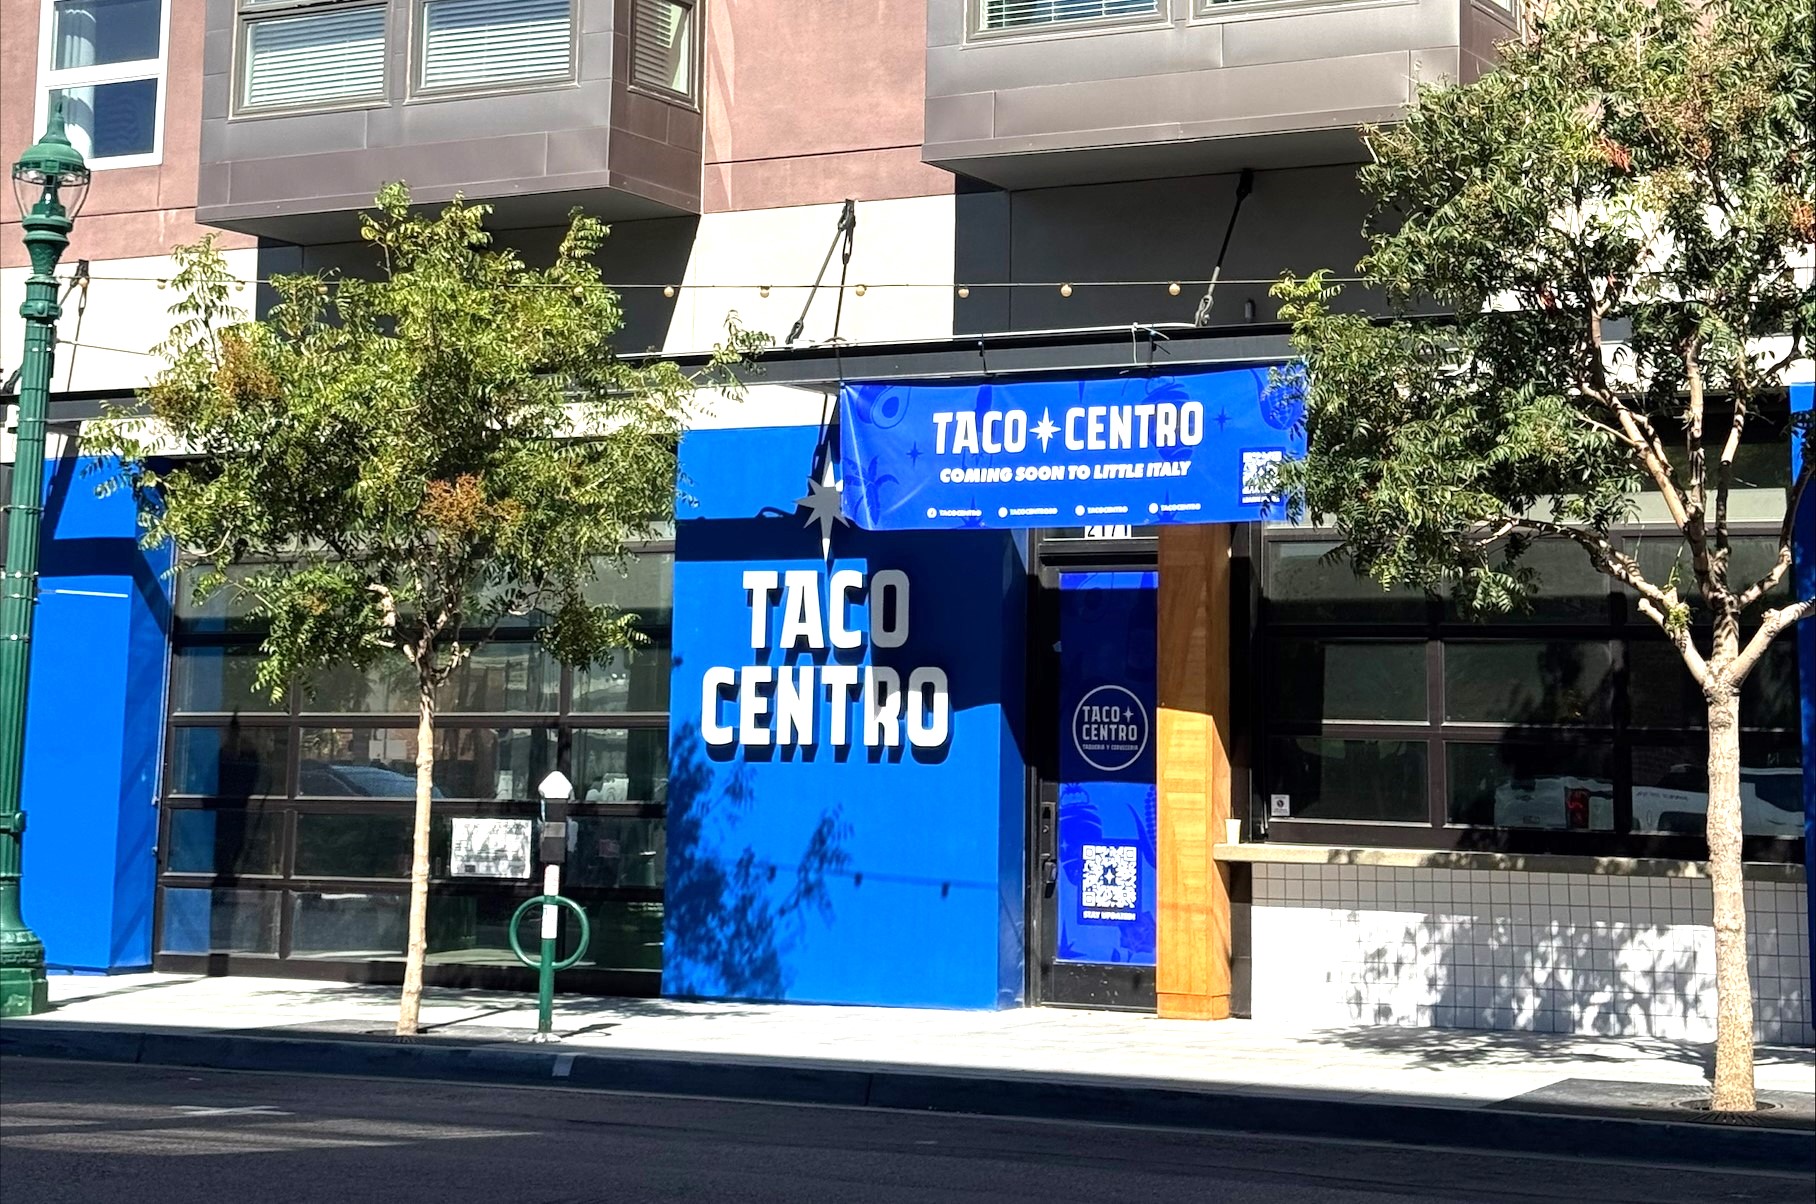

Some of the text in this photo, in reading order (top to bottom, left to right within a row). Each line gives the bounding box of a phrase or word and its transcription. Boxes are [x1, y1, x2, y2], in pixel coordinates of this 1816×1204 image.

[933, 401, 1204, 454] TACO CENTRO
[940, 461, 1192, 483] COMING SOON TO LITTLE ITALY
[743, 569, 910, 649] TACO
[701, 666, 948, 747] CENTRO
[1082, 705, 1120, 723] TACO
[1082, 724, 1138, 741] CENTRO
[1083, 911, 1100, 919] STAY
